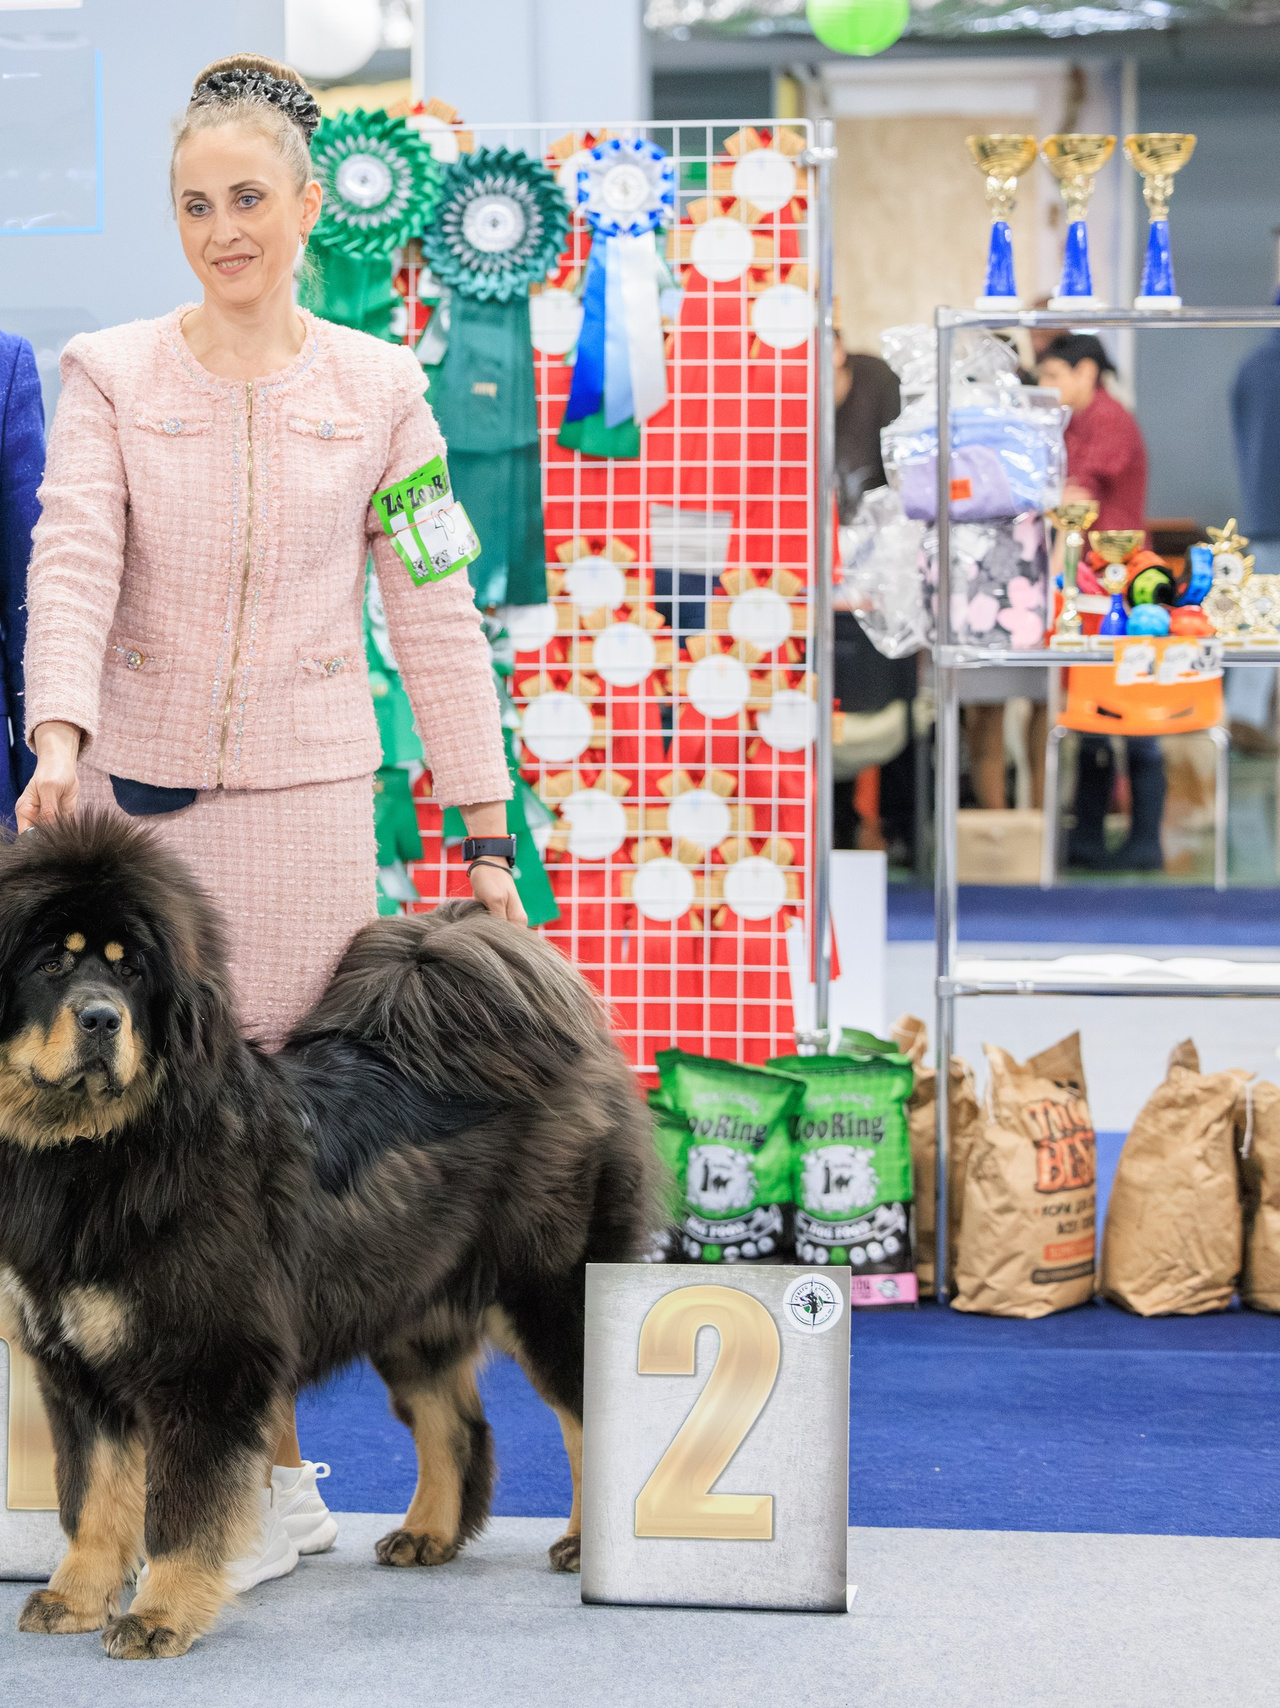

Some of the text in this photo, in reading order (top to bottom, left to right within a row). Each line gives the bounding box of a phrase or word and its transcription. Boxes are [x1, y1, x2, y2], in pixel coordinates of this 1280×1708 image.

[431, 508, 456, 541] 40
[687, 1114, 768, 1150] ooRing
[635, 1285, 780, 1539] 2
